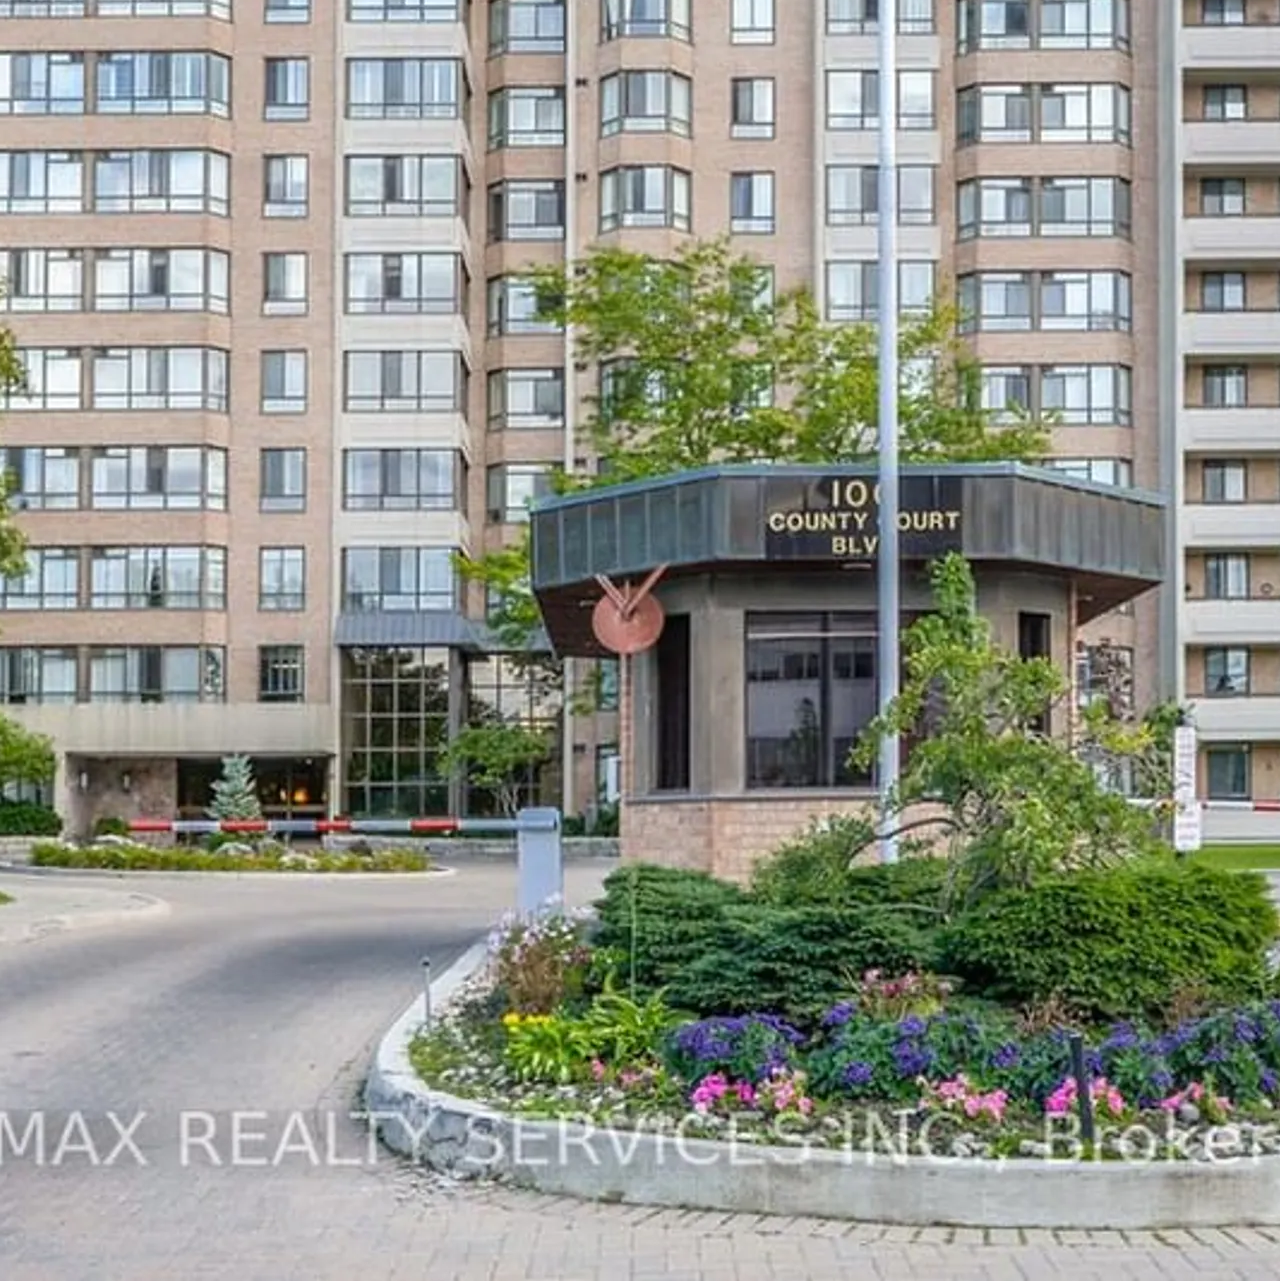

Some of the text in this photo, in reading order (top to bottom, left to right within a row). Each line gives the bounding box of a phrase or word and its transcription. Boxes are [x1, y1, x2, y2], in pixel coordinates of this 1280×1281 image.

[770, 511, 960, 532] COUNTY OURT
[832, 536, 880, 554] BLV
